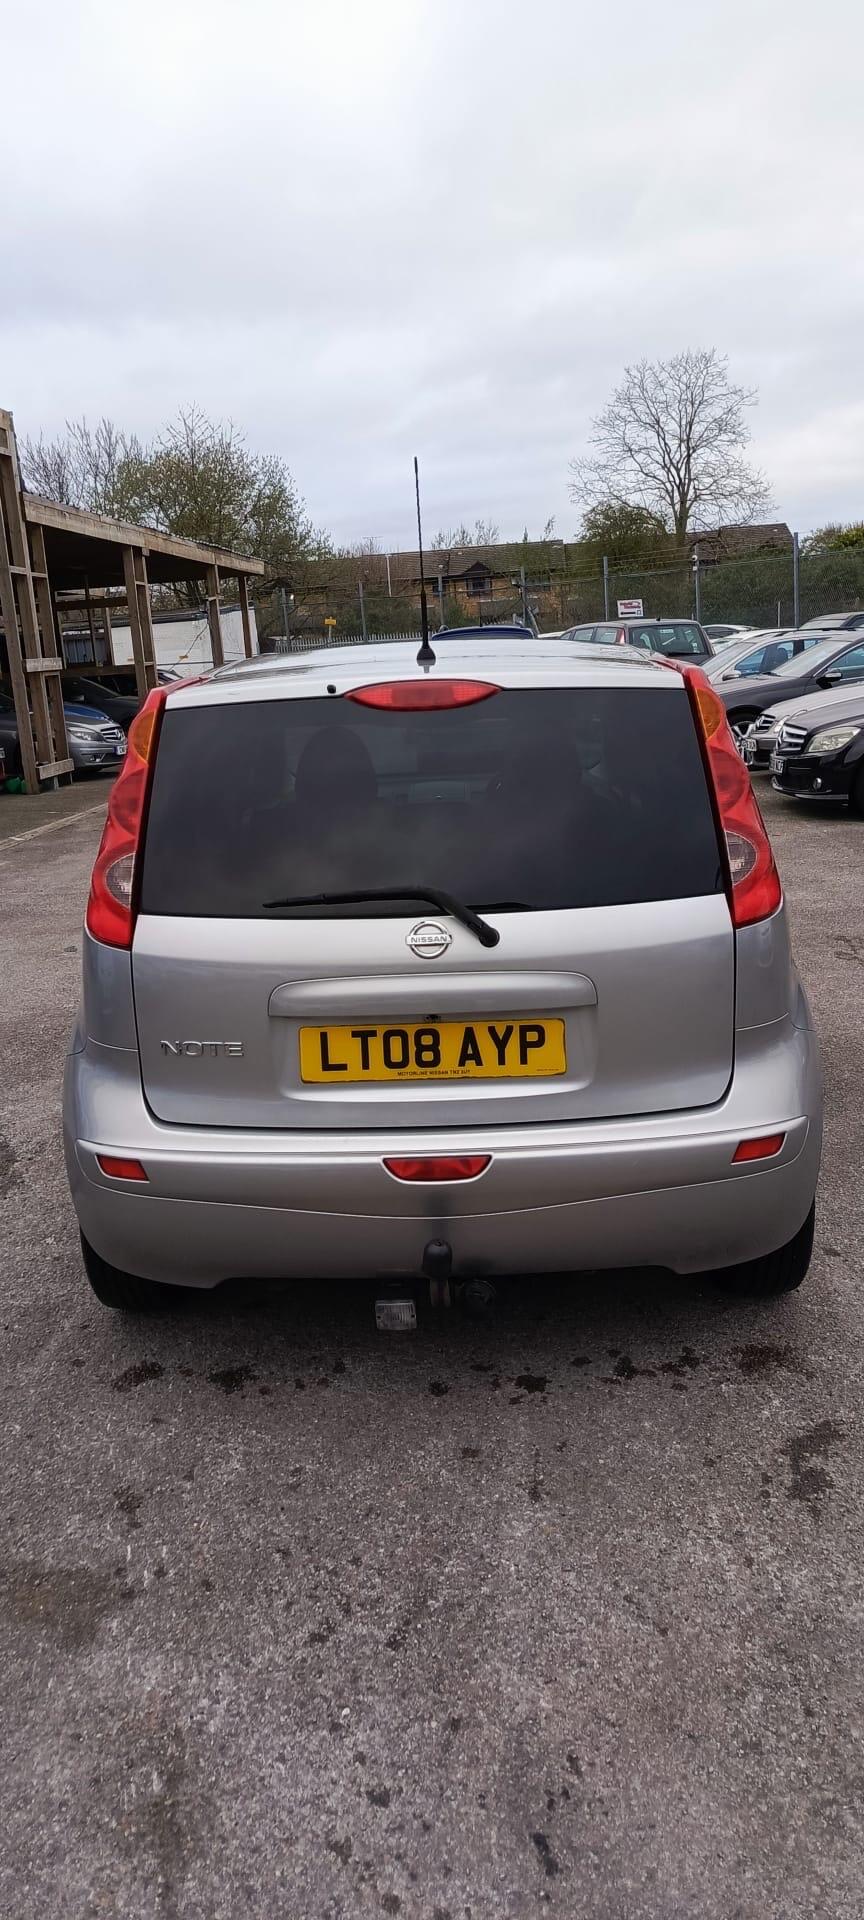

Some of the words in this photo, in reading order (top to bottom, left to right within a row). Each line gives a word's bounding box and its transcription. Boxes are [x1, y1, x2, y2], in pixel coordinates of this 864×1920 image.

[160, 1040, 244, 1056] NOTE
[319, 1027, 441, 1072] LT08
[457, 1024, 546, 1067] AYP
